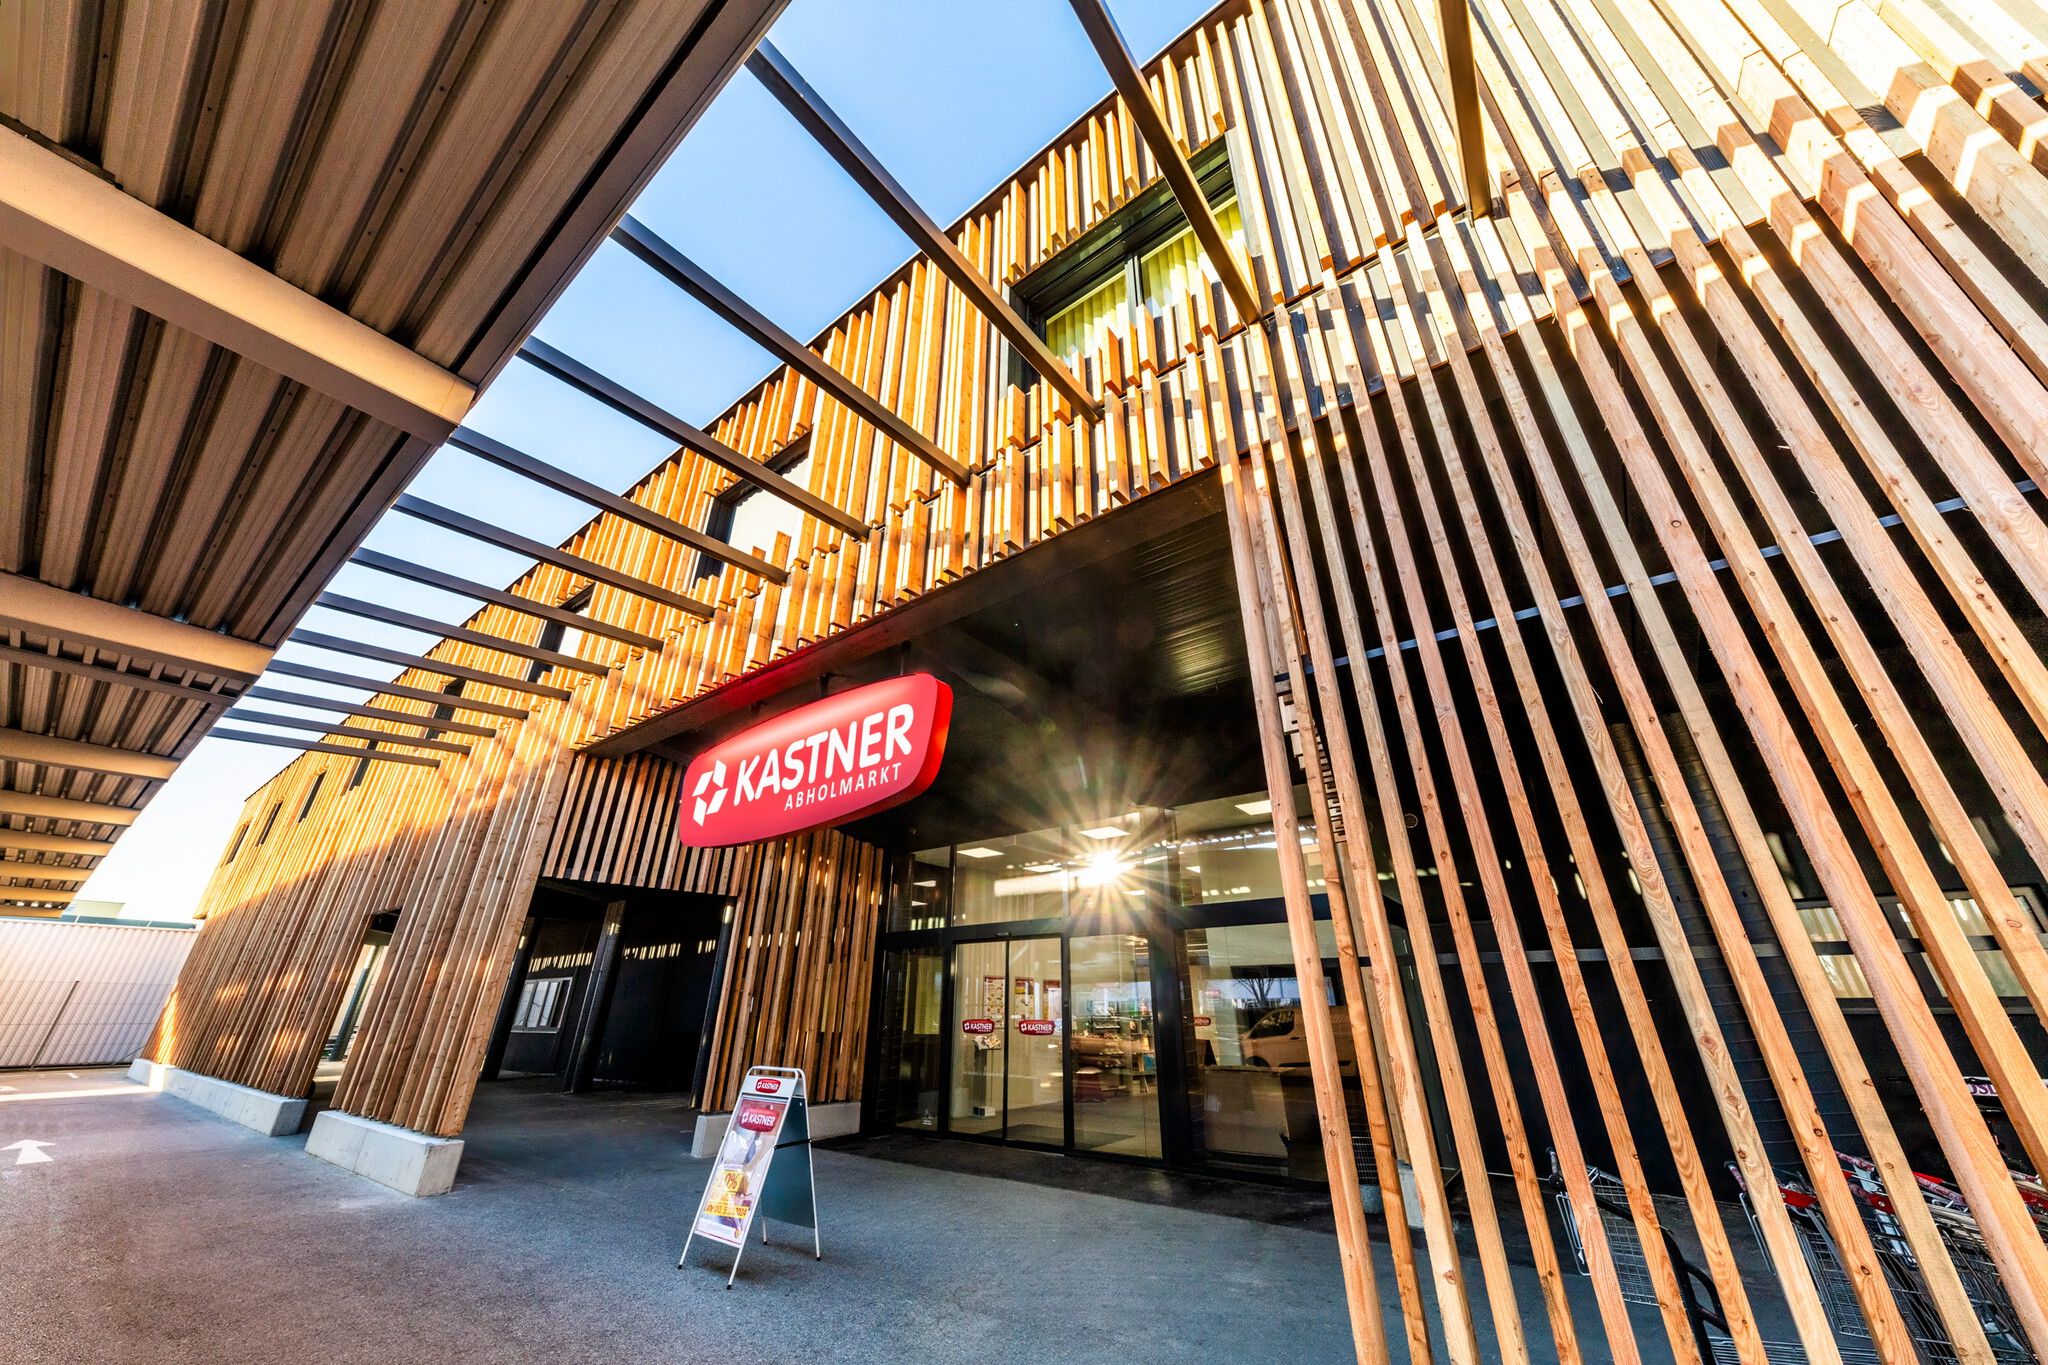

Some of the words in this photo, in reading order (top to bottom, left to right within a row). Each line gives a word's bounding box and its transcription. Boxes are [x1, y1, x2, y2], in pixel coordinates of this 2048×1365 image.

[733, 703, 914, 806] KASTNER
[784, 762, 902, 811] ABHOLMARKT
[969, 1022, 993, 1031] KASTNER
[1027, 1023, 1053, 1032] KASTNER
[761, 1082, 779, 1090] KASTNER
[748, 1112, 776, 1127] KASTNER
